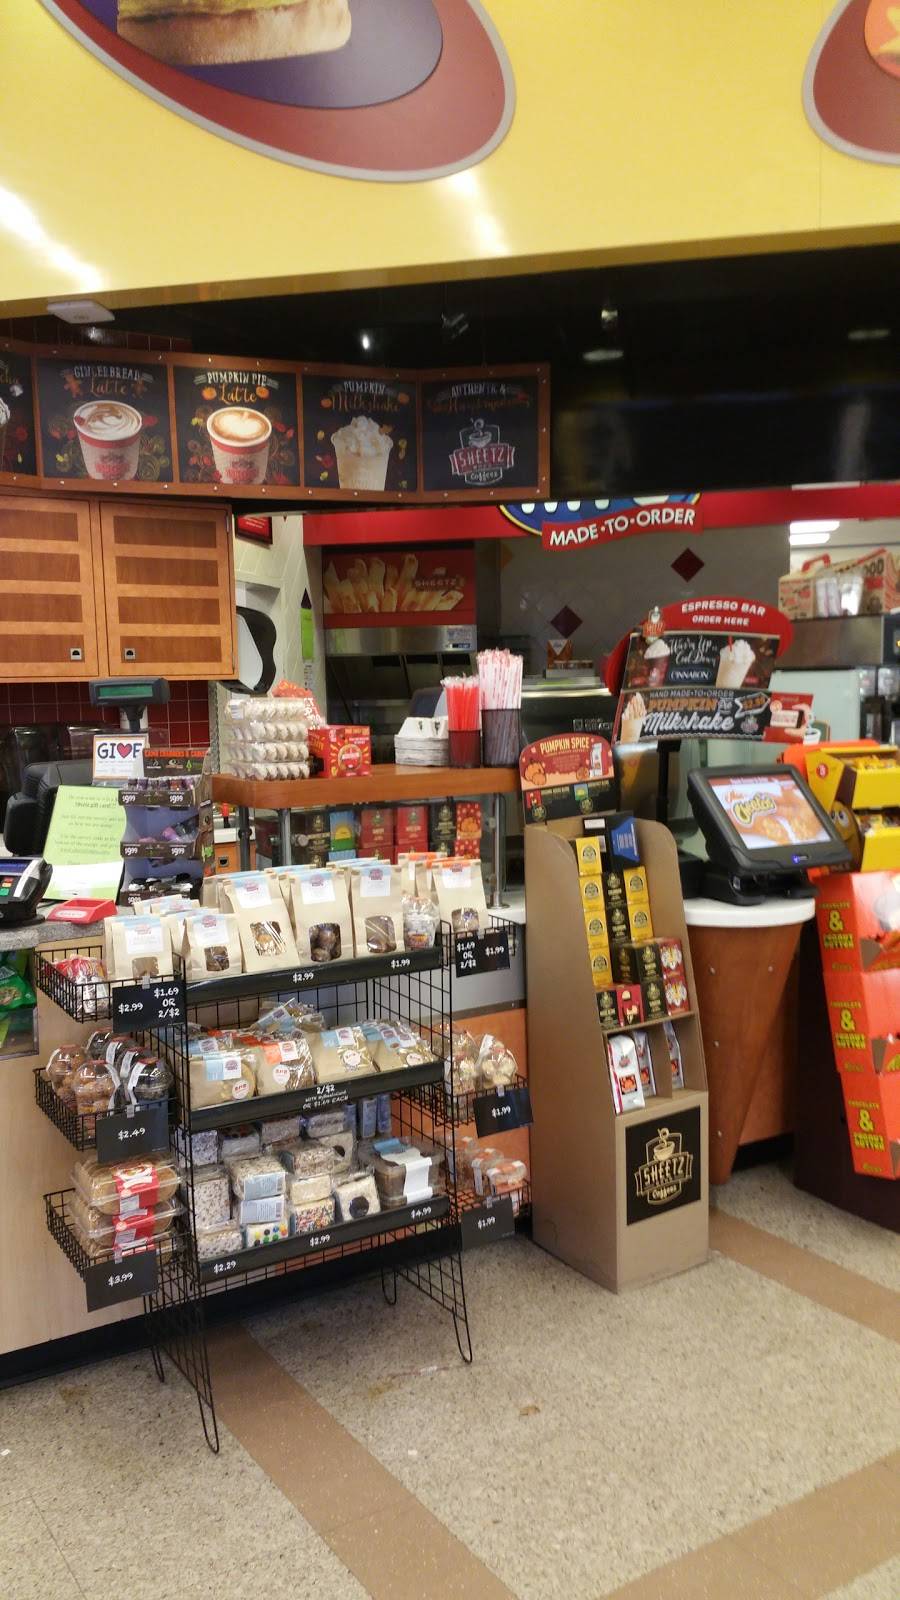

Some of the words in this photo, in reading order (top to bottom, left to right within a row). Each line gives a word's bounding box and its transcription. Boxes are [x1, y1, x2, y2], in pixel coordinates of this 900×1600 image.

[74, 366, 140, 381] GINGERBREAD
[207, 371, 250, 385] PUMPKIN
[252, 373, 268, 387] PIE
[220, 383, 257, 404] Latte
[343, 380, 385, 395] PUMPKIN
[459, 447, 504, 467] SHEETZ
[682, 600, 738, 614] ESPRESSO
[741, 601, 766, 616] BAR
[692, 615, 722, 625] ORDER
[724, 616, 749, 626] HERE
[670, 671, 709, 681] CINNABON
[648, 697, 718, 712] PUMPKIN
[643, 712, 735, 735] Milkshake
[540, 738, 570, 755] PUMPKIN
[571, 736, 590, 750] SPICE
[462, 951, 473, 960] OR
[390, 957, 411, 969] $1.99
[292, 972, 314, 984] $2.99
[153, 987, 179, 999] $1.69
[118, 1002, 144, 1015] $2.99
[162, 998, 176, 1008] OR
[158, 1007, 181, 1019] 2/$2
[316, 1084, 335, 1095] 2/$2
[331, 1095, 349, 1104] EACH
[491, 1105, 511, 1119] $1.99
[118, 1127, 146, 1142] $2.49
[644, 1156, 685, 1186] SHEETZ
[410, 1206, 432, 1220] $4.99
[309, 1234, 331, 1247] $2.99
[213, 1260, 237, 1275] $2.29
[107, 1271, 134, 1287] $3.99
